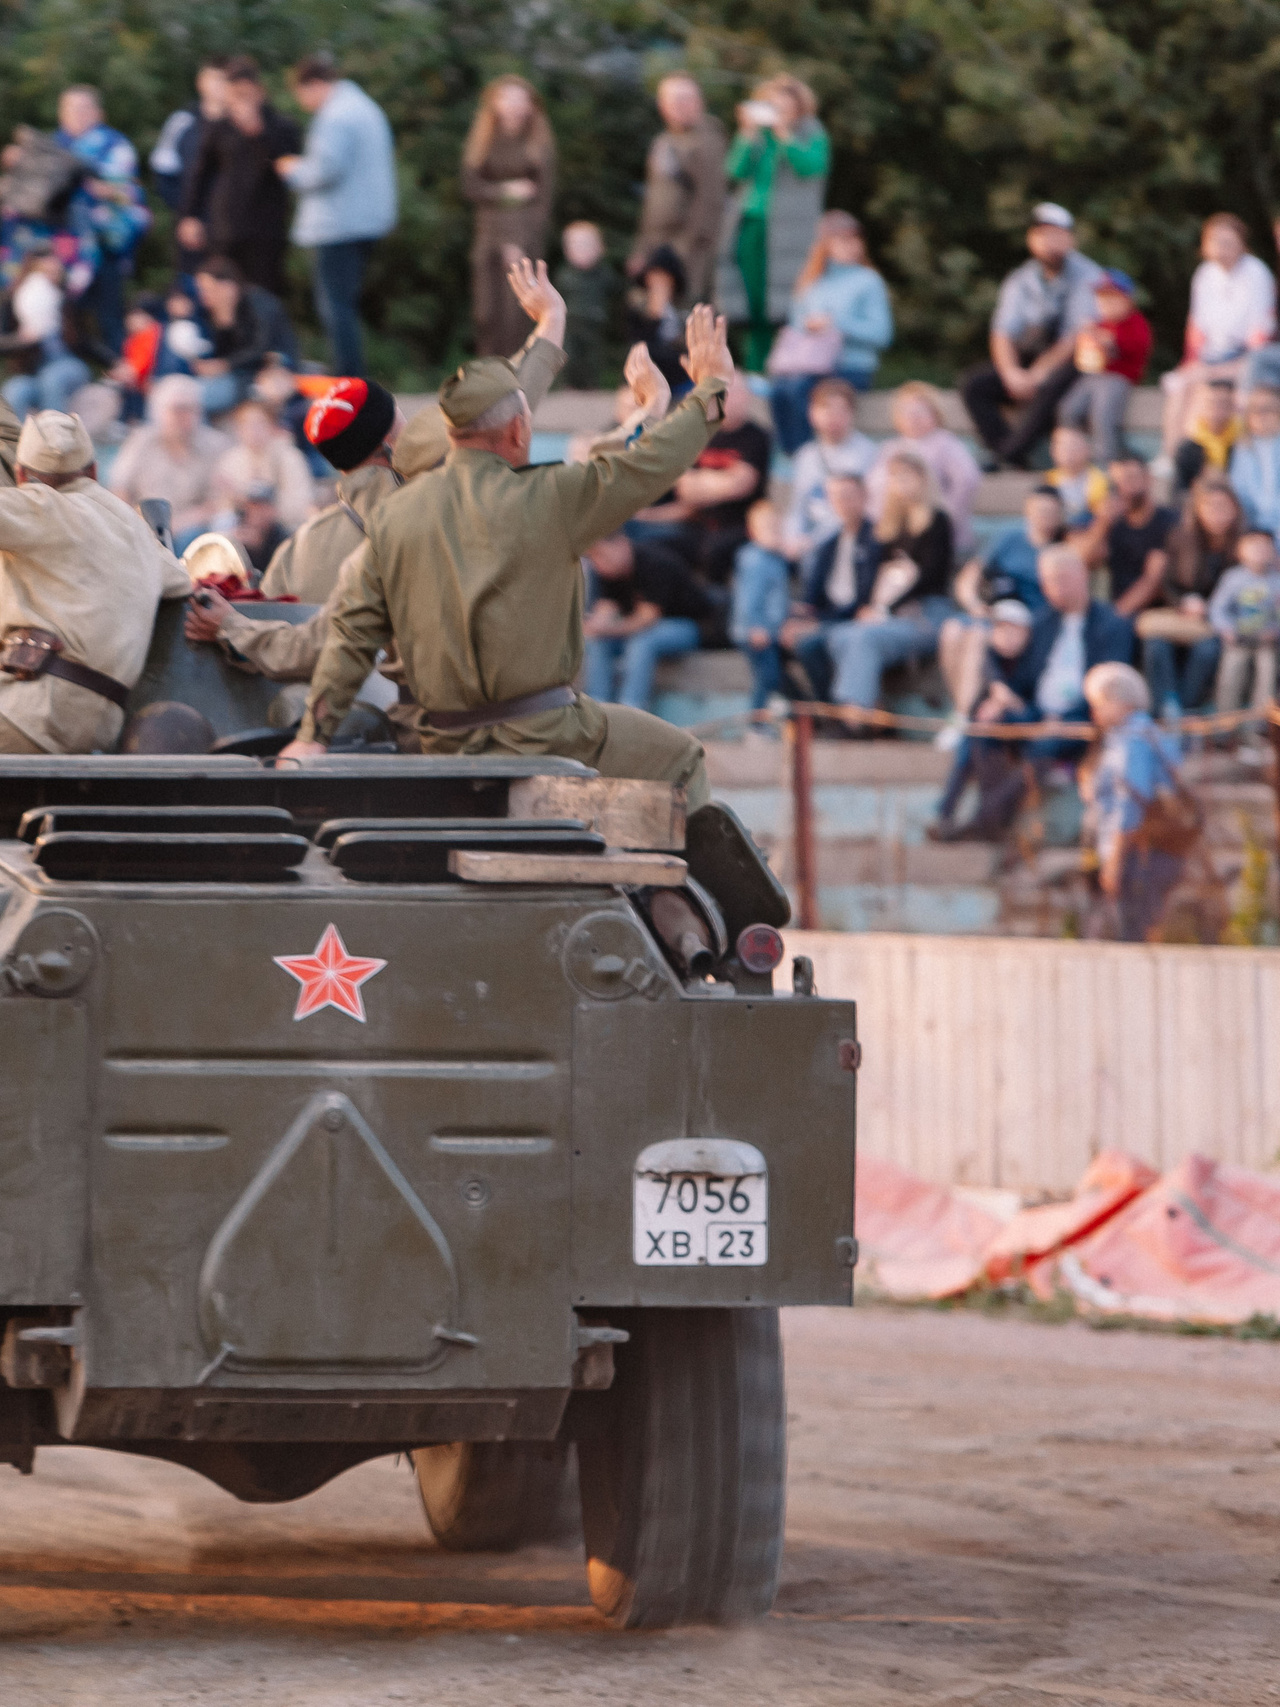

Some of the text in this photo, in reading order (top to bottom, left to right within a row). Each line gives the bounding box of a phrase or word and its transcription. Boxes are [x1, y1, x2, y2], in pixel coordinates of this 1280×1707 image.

[652, 1177, 750, 1213] 7056
[646, 1230, 754, 1258] ХВ 23
